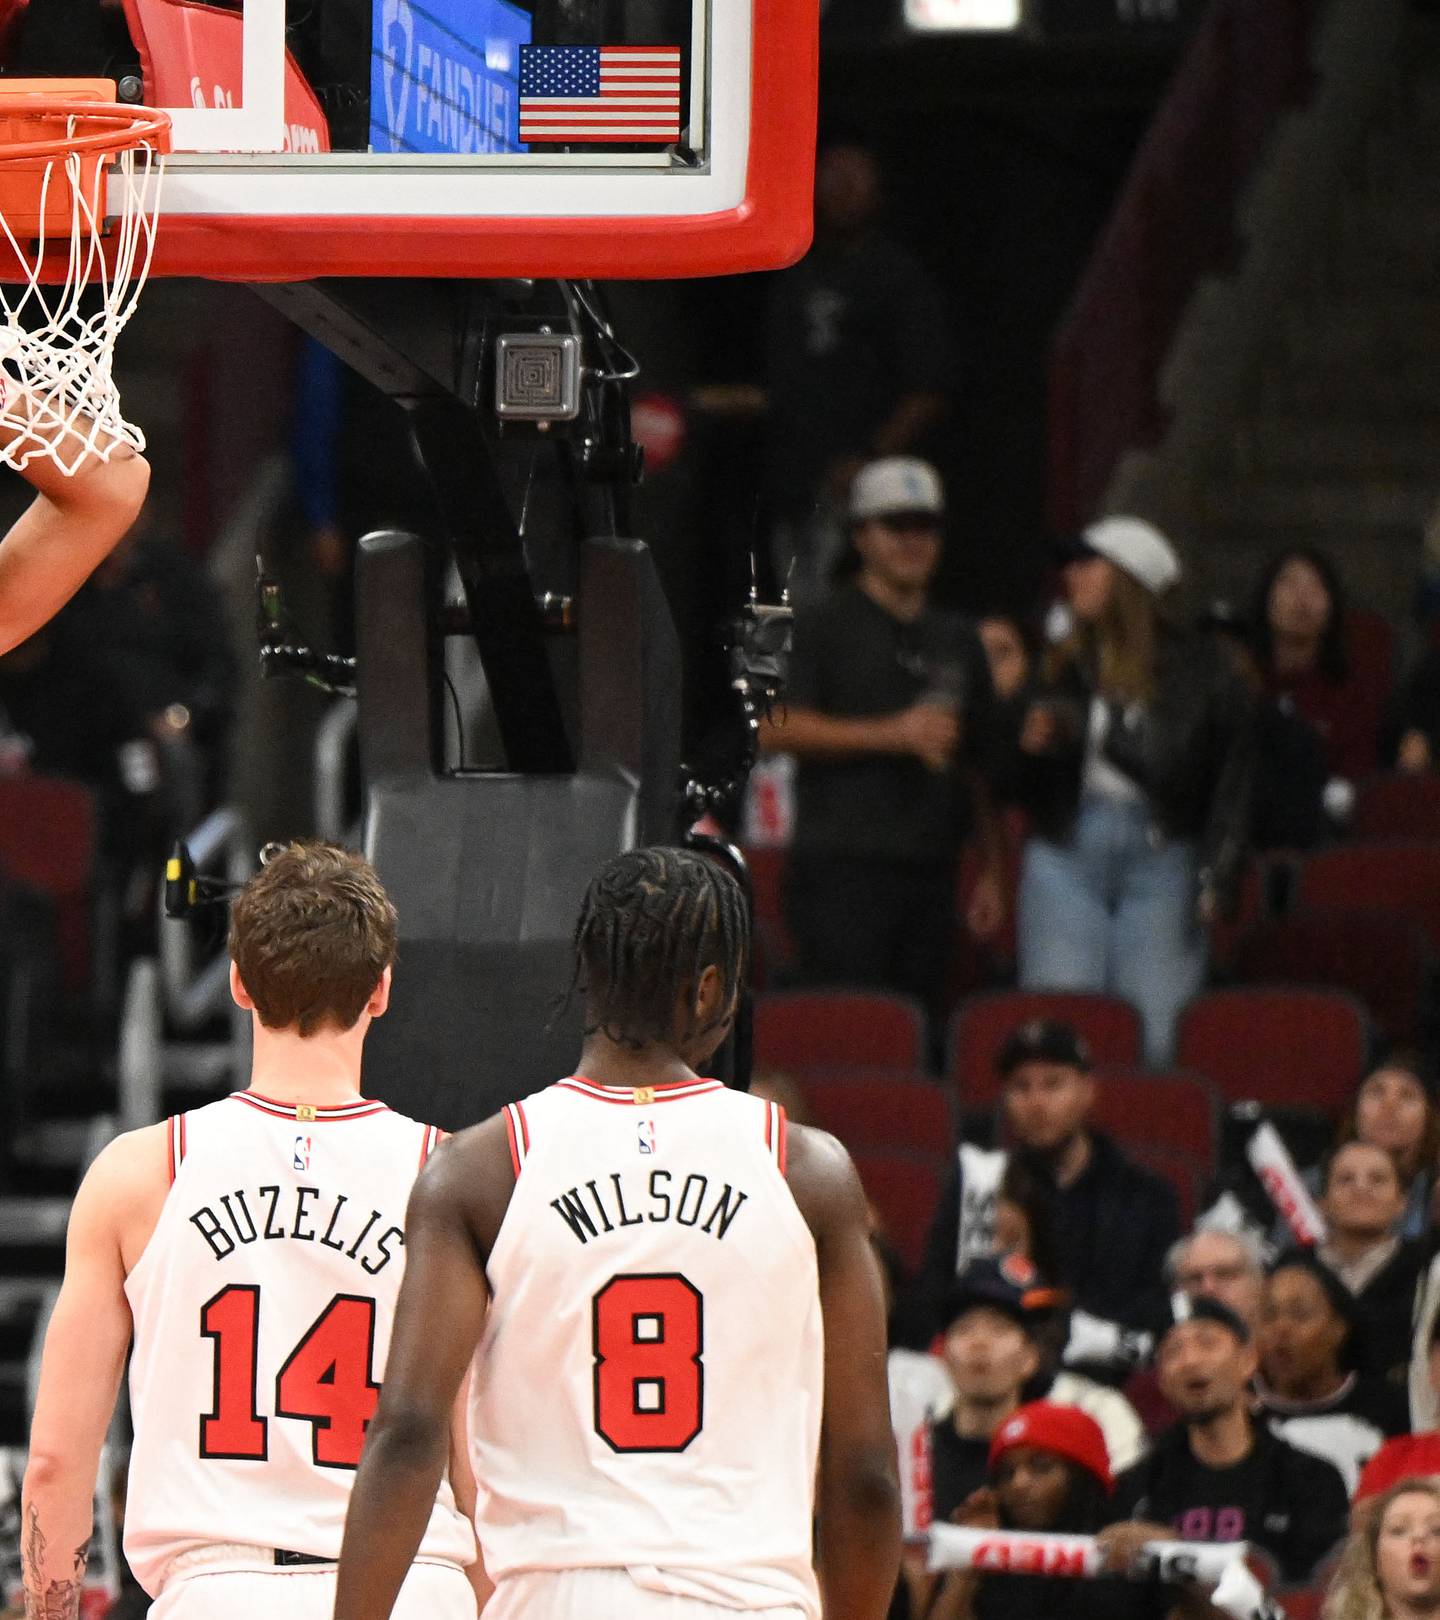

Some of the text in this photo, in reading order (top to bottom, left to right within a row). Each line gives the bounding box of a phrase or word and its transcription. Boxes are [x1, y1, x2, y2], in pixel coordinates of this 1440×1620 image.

[189, 1185, 405, 1275] BUZELIS
[550, 1170, 748, 1244] WILSON
[199, 1283, 382, 1470] 14
[591, 1272, 704, 1453] 8
